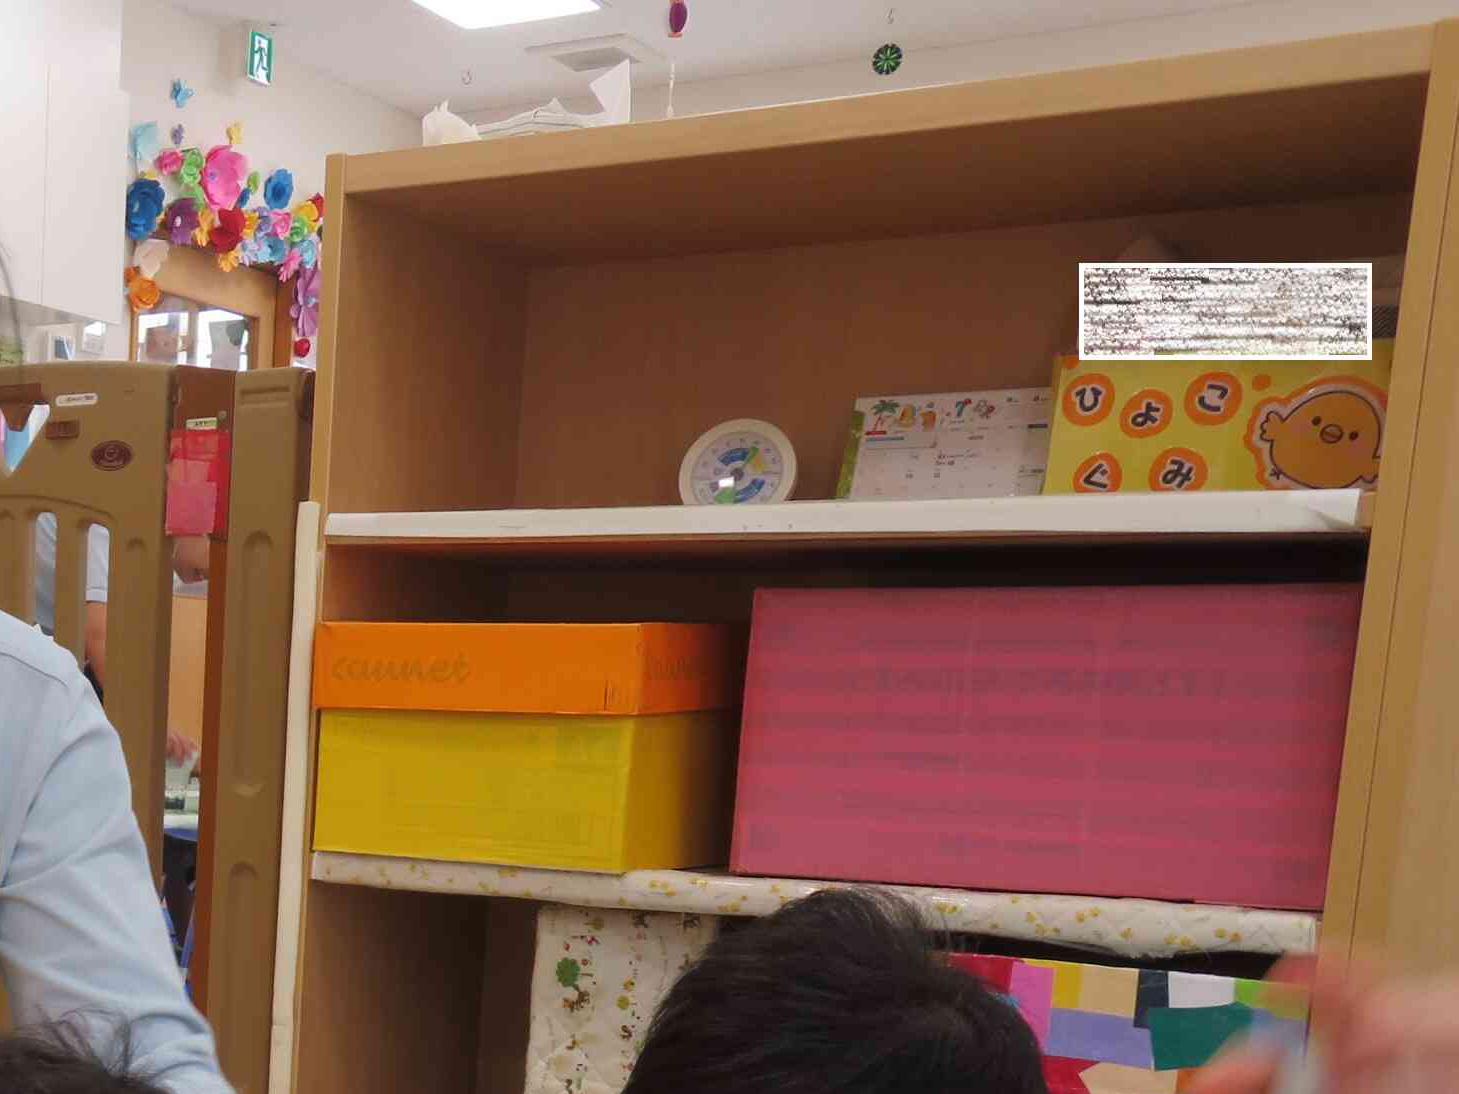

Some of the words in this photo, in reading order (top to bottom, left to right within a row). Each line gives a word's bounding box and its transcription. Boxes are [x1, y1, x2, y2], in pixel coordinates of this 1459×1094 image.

[1073, 382, 1230, 429] ひよこ
[1081, 457, 1197, 490] ぐみ
